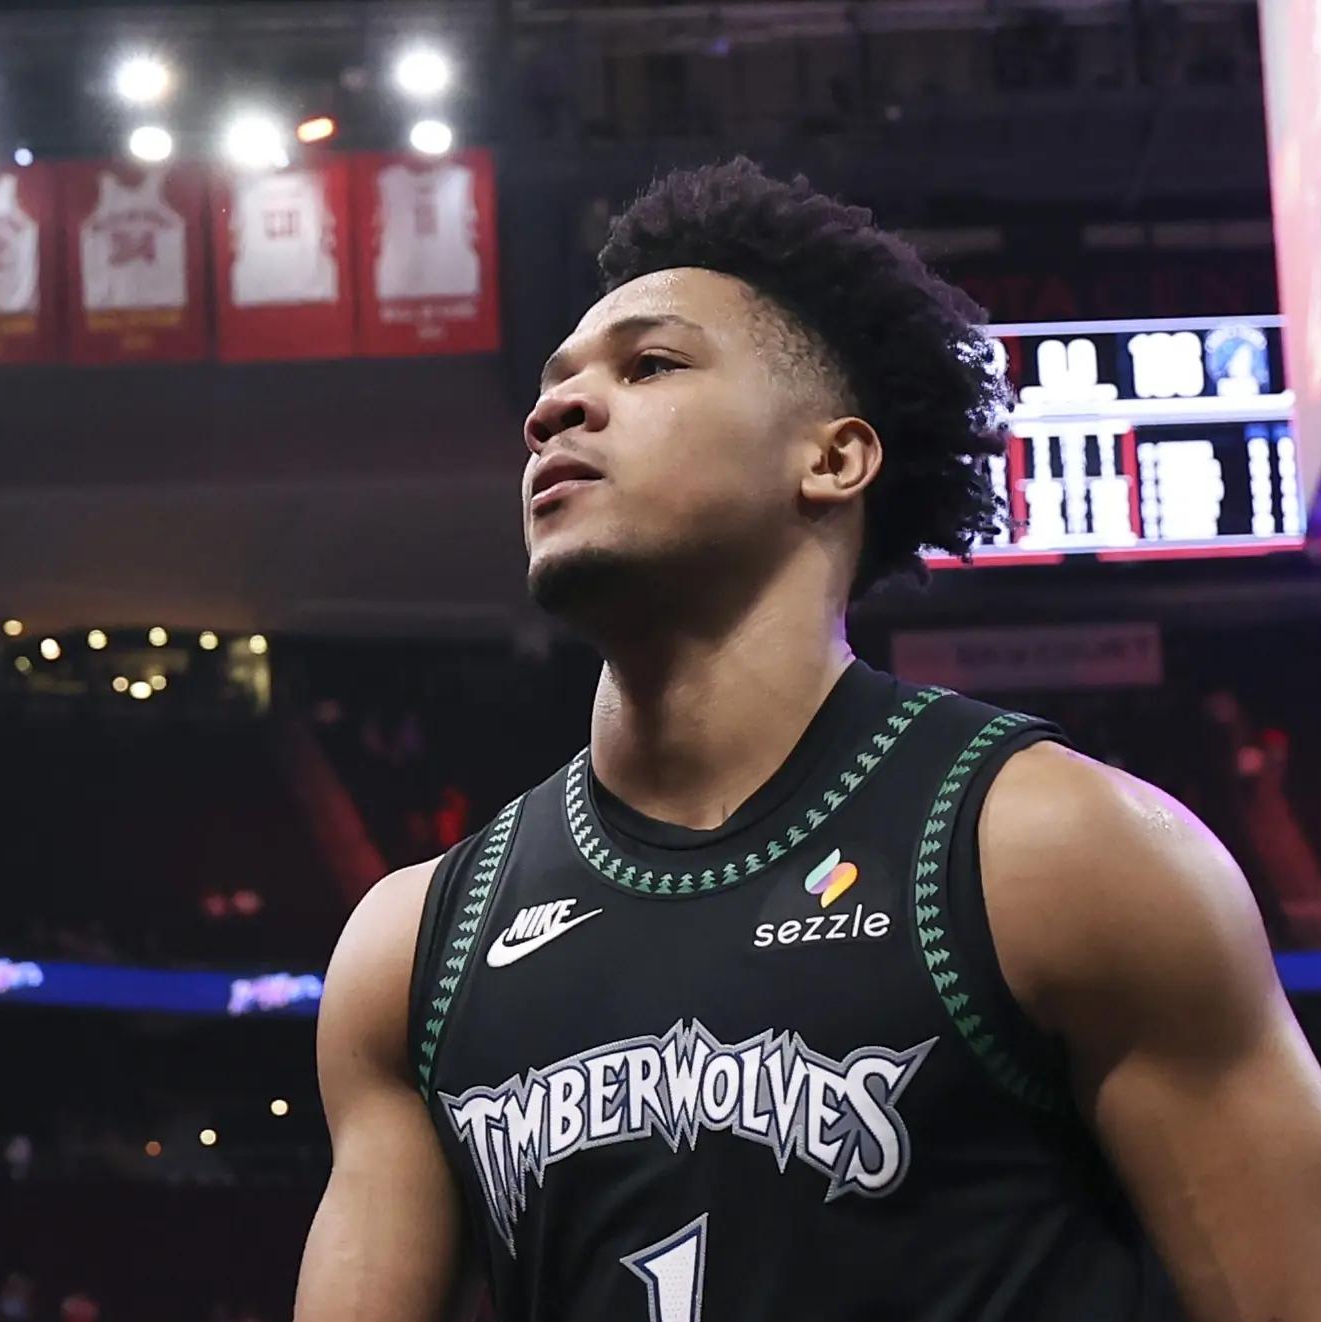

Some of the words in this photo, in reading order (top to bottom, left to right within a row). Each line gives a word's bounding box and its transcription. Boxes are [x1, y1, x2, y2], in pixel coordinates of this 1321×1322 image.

[504, 898, 578, 942] NIKE
[753, 903, 891, 948] sezzle
[437, 1017, 941, 1259] TIMBERWOLVES
